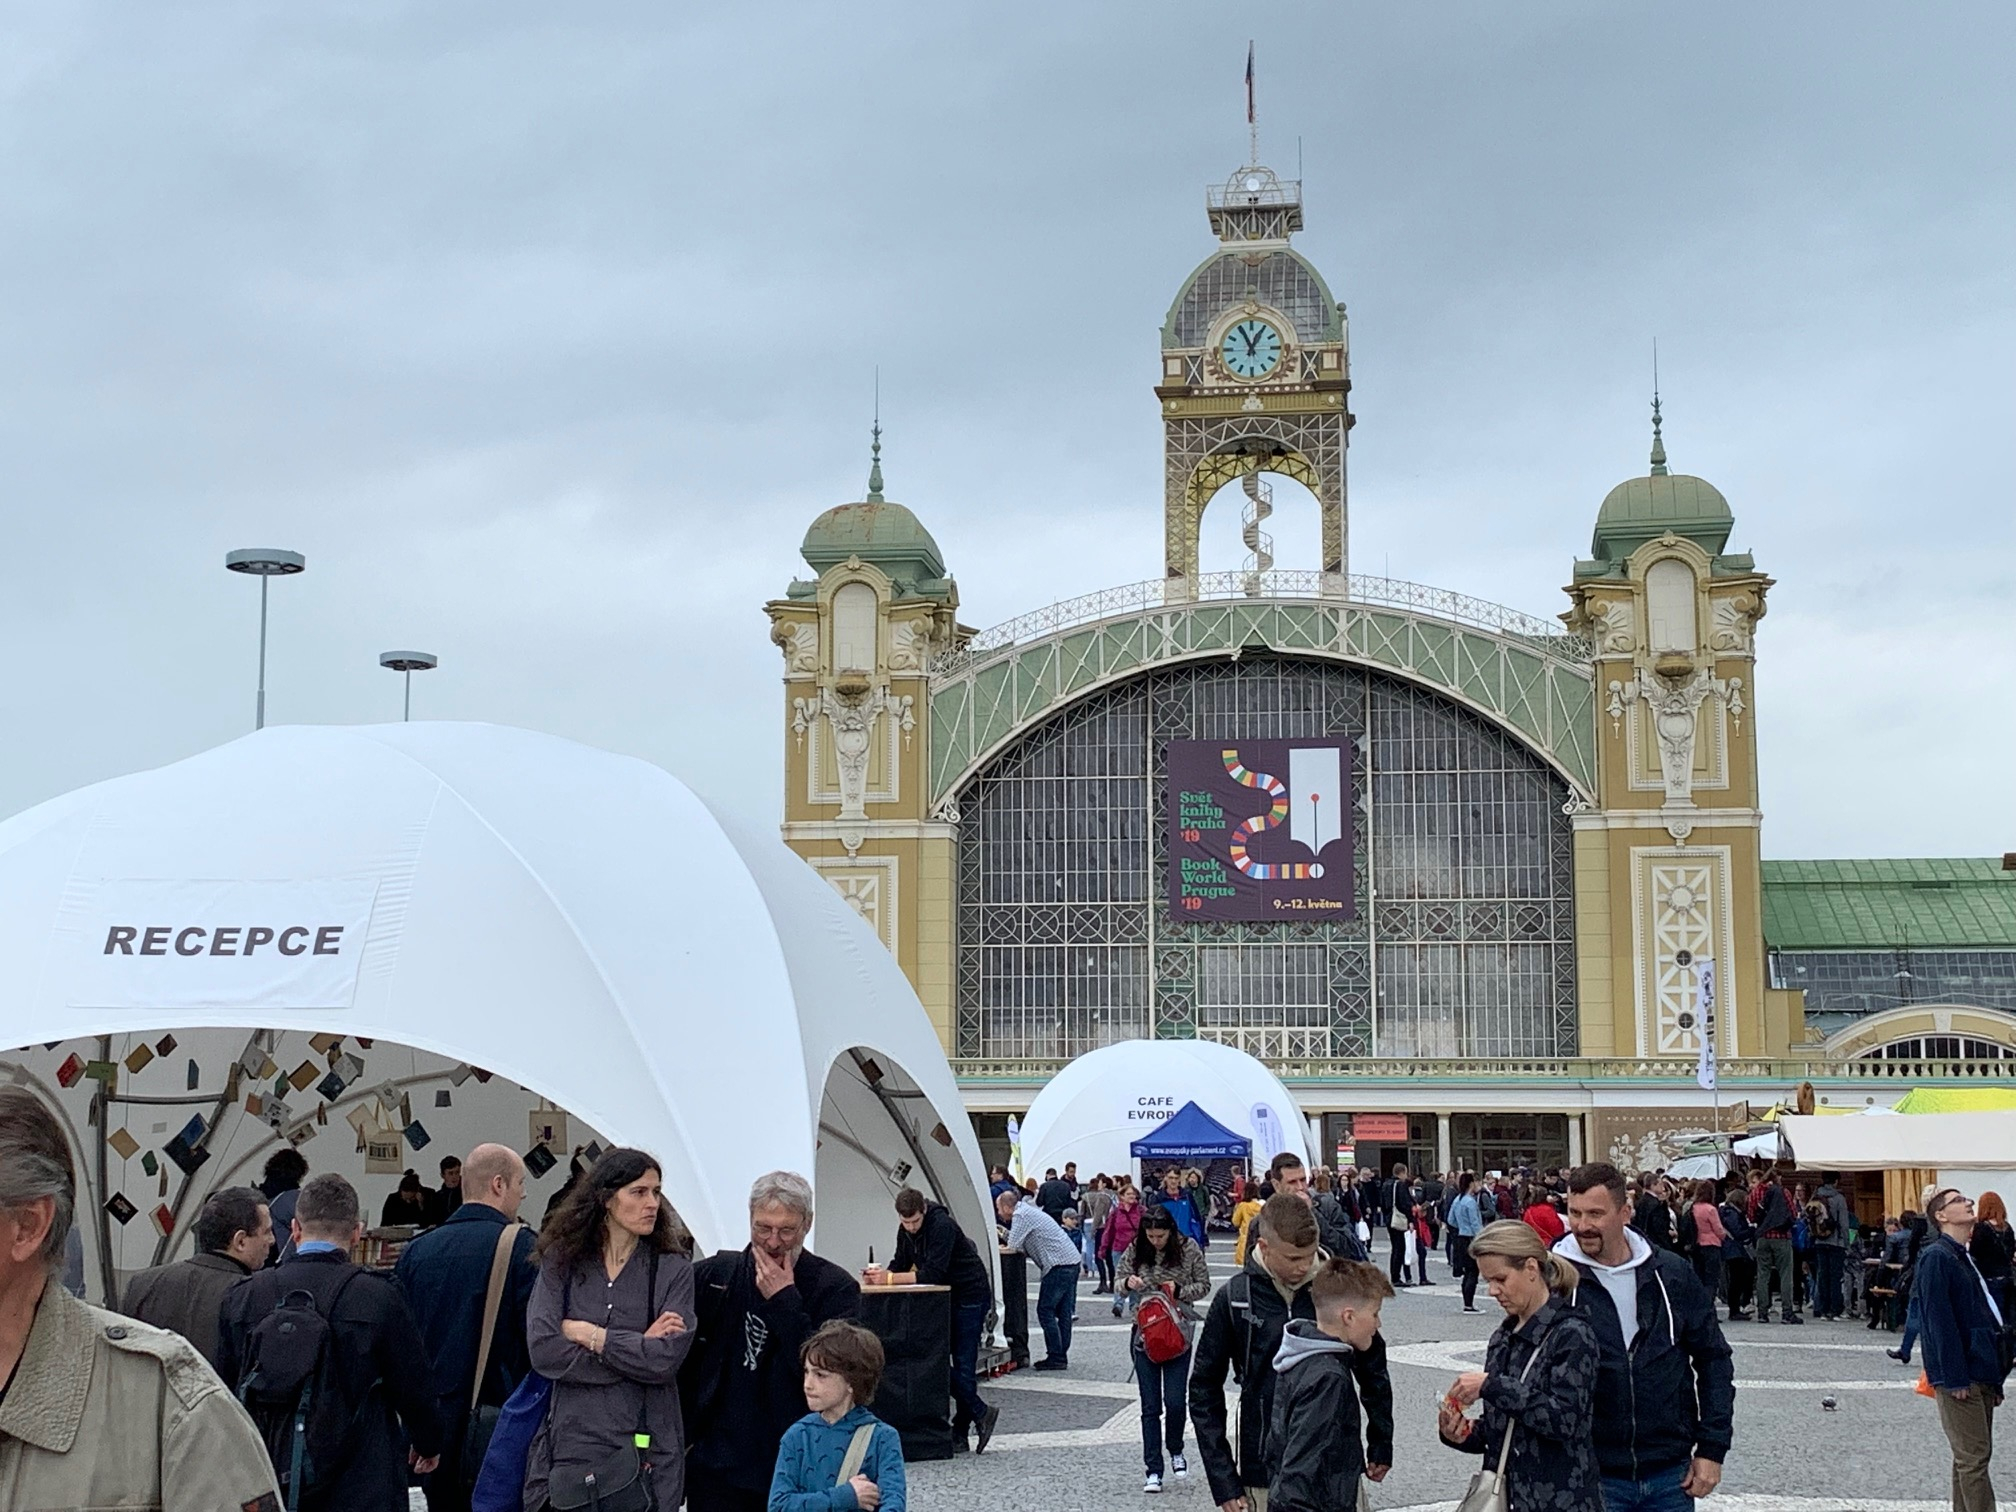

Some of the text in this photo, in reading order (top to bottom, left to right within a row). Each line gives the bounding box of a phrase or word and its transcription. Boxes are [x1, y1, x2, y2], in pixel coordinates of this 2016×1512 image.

[1180, 791, 1213, 803] Svět
[1180, 804, 1223, 819] knihy
[1180, 816, 1226, 829] Praha
[1181, 857, 1221, 870] Book
[1180, 870, 1226, 883] World
[1181, 884, 1236, 899] Prague
[1307, 898, 1343, 909] května
[103, 925, 344, 956] RECEPCE
[1128, 1110, 1178, 1120] EVROP
